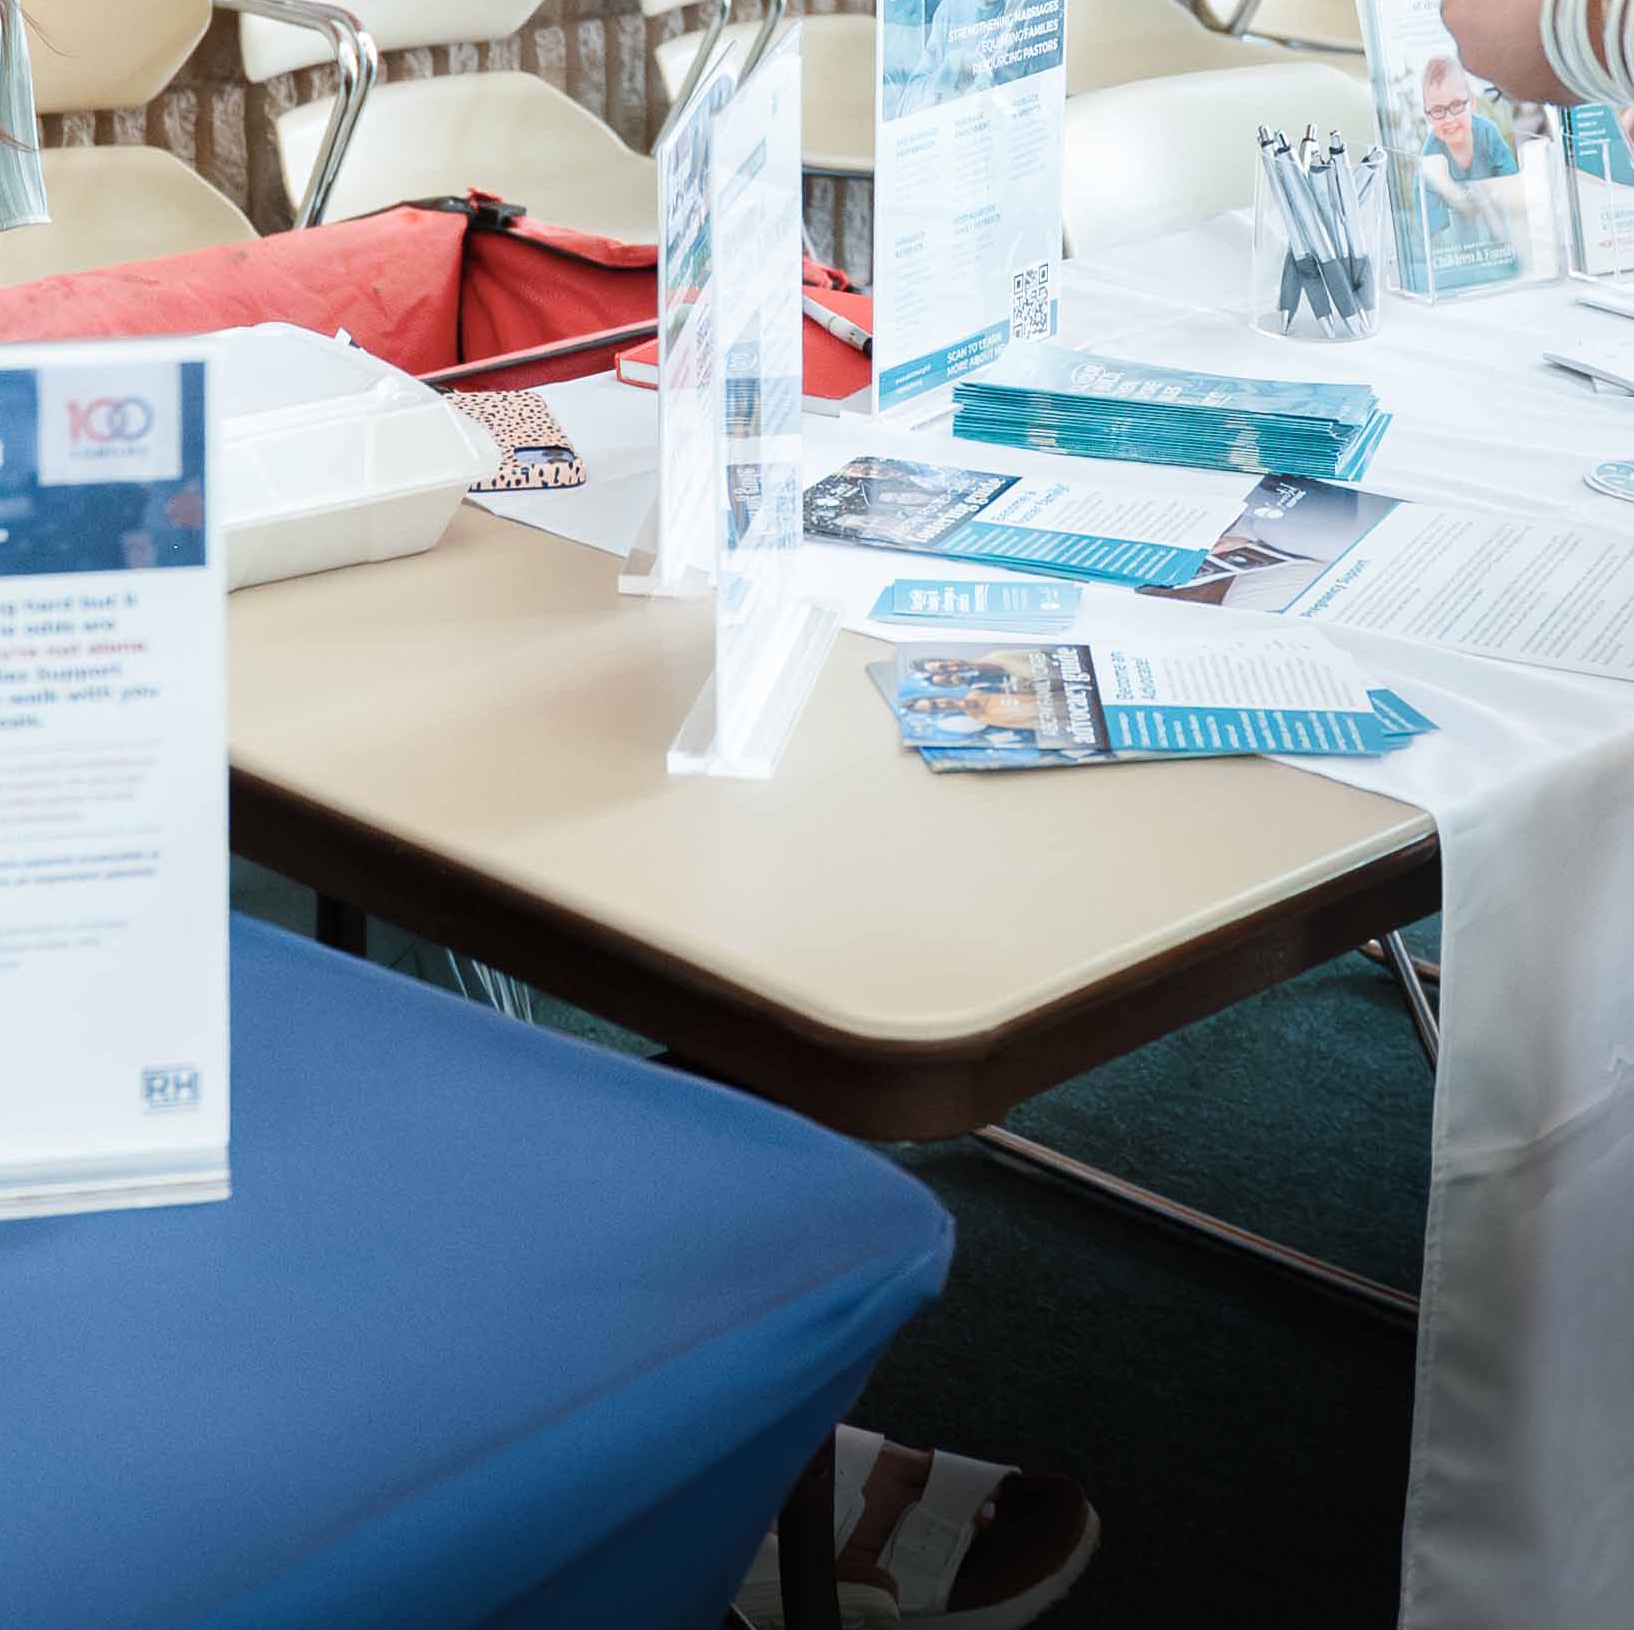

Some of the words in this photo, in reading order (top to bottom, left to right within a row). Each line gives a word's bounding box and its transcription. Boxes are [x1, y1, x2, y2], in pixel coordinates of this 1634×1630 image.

[1023, 18, 1059, 41] FAMILIES
[1023, 37, 1059, 60] PASTORS
[946, 347, 967, 364] SCAN
[66, 396, 154, 444] 100
[1053, 646, 1089, 682] guide
[1064, 683, 1096, 745] advocacy
[142, 1070, 199, 1104] RH
